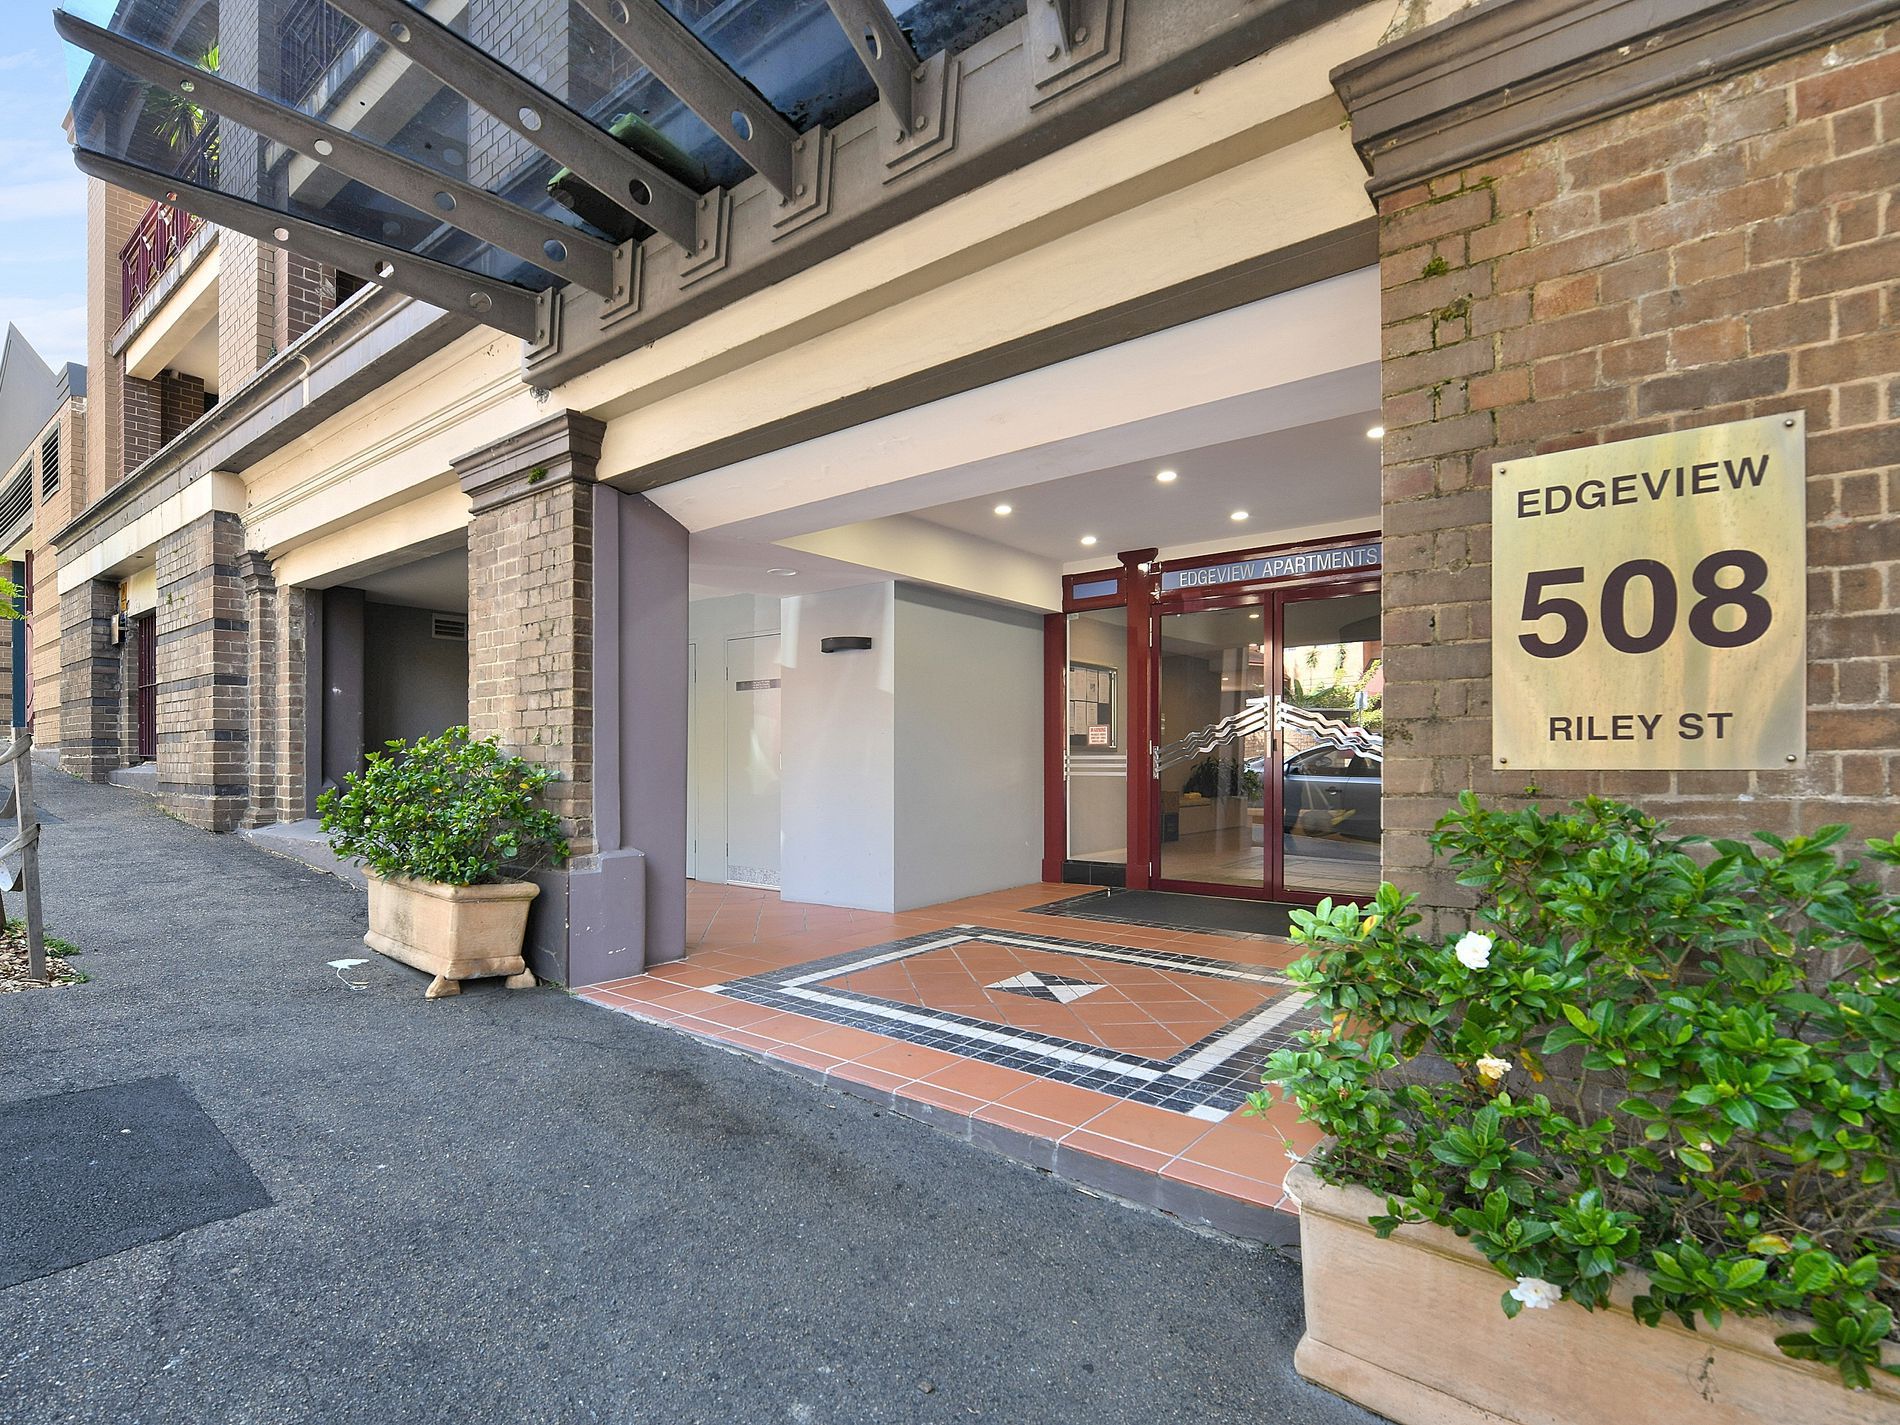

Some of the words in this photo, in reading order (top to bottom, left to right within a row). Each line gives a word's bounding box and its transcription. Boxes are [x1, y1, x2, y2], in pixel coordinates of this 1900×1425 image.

[1517, 454, 1770, 519] EDGEVIEW
[1179, 565, 1255, 587] EDGEVIEW
[1262, 549, 1378, 577] APARTMENTS
[1518, 549, 1773, 659] 508
[1549, 714, 1663, 741] RILEY
[1678, 712, 1734, 740] ST
